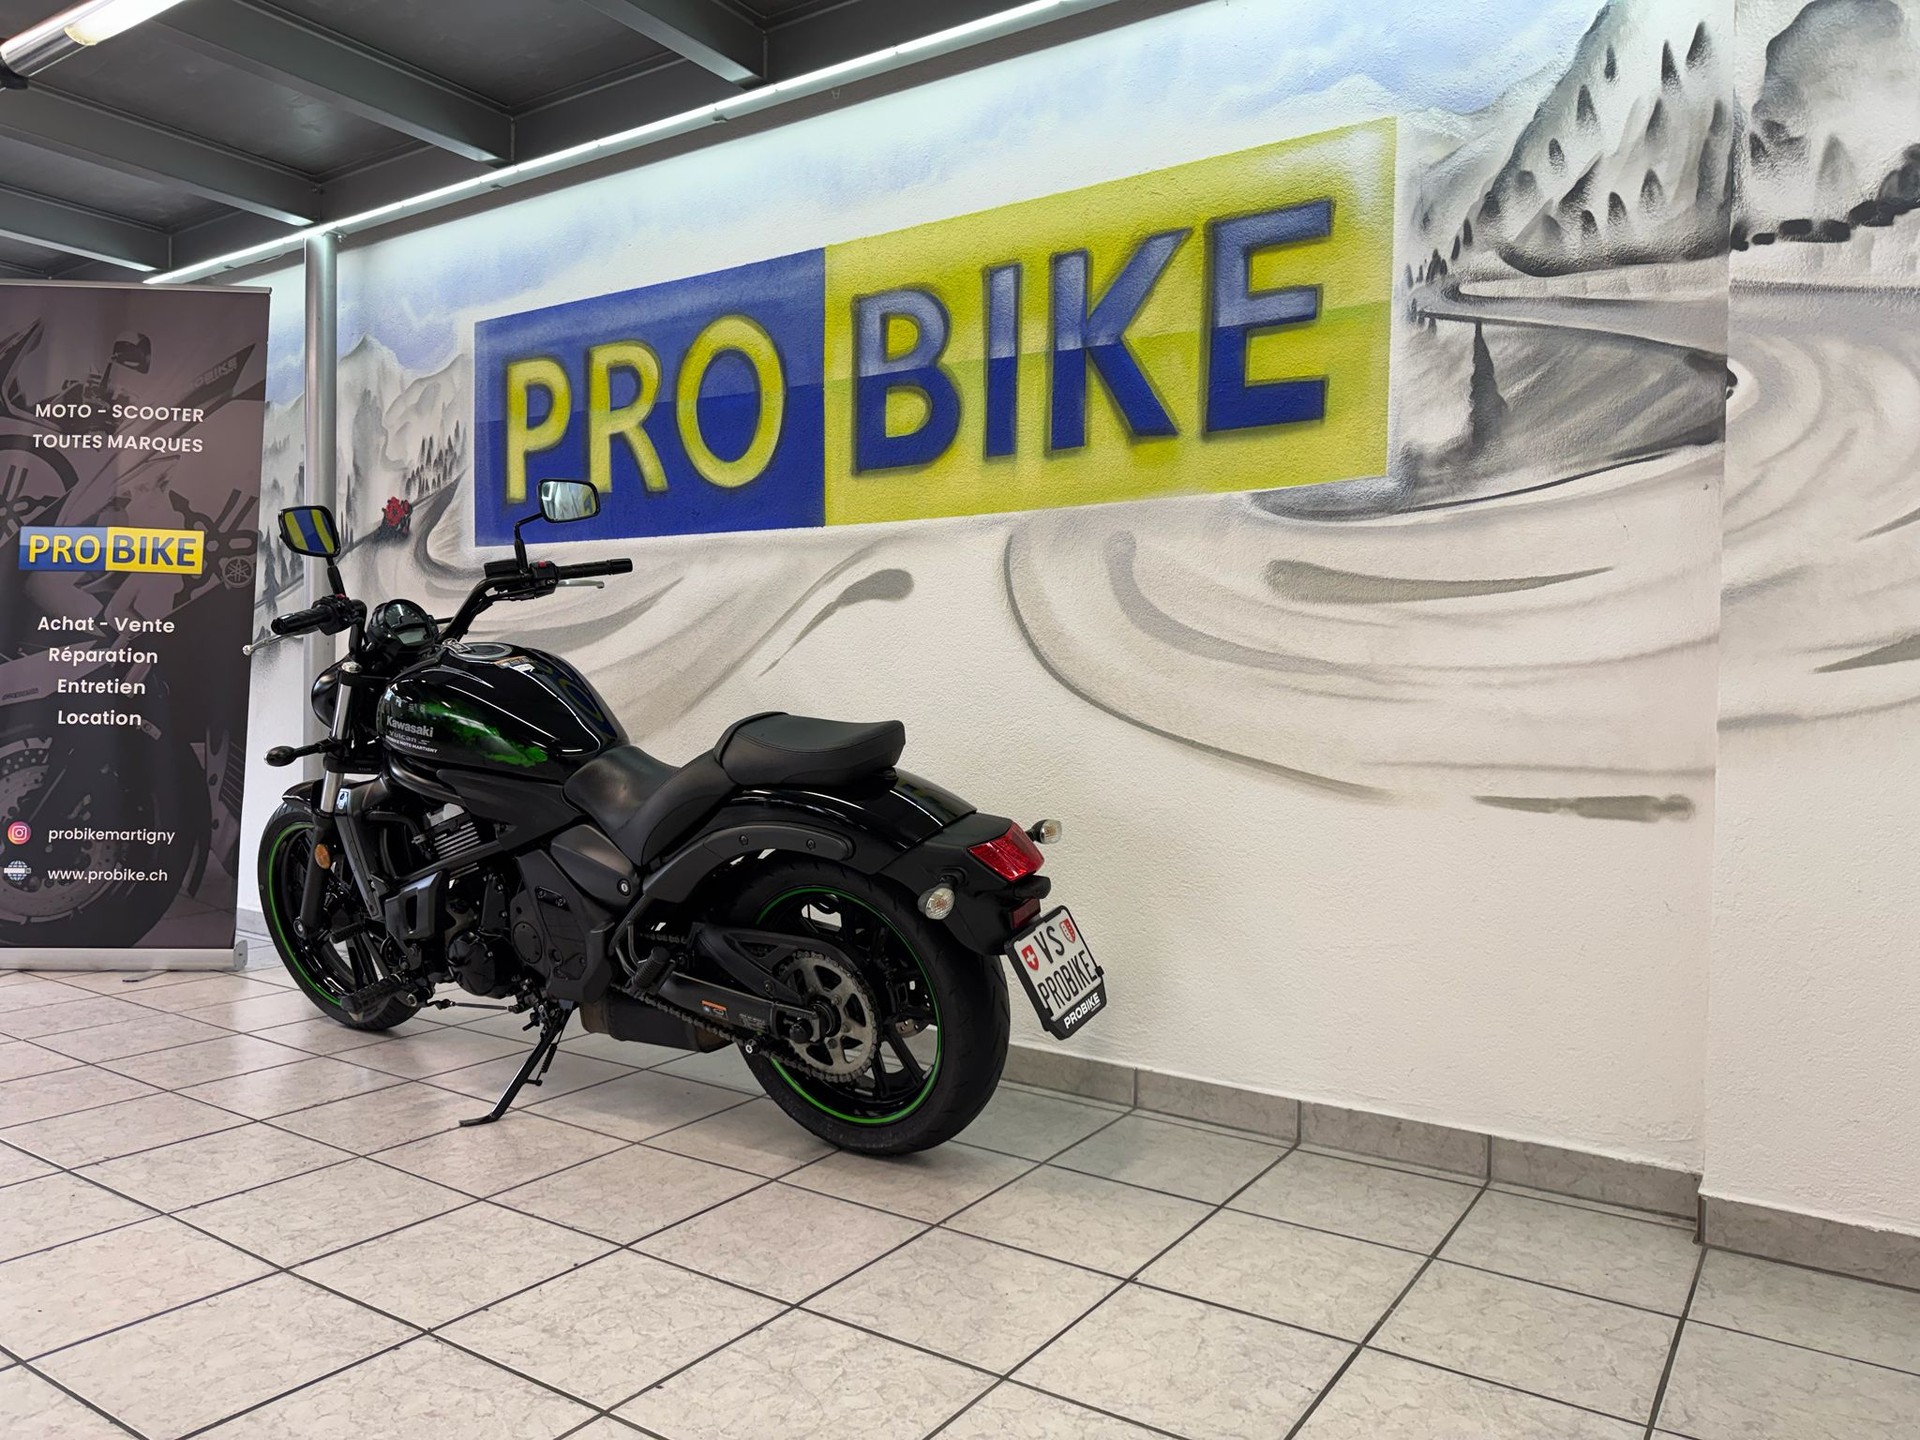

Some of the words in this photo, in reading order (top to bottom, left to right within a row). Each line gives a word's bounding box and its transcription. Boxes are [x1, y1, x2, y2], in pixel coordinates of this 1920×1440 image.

[505, 317, 784, 504] PRO
[852, 199, 1336, 475] BIKE
[35, 403, 92, 418] MOTO
[112, 404, 204, 423] SCOOTER
[33, 433, 103, 449] TOUTES
[107, 434, 203, 454] MARQUES
[28, 534, 101, 564] PRO
[112, 534, 196, 567] BIKE
[37, 615, 95, 631] Achat
[114, 617, 175, 633] Vente
[48, 646, 158, 667] Réparation
[57, 678, 146, 696] Entretien
[57, 709, 142, 727] Location
[386, 715, 434, 738] Kawasaki
[48, 827, 176, 846] probikemartigny
[47, 868, 169, 884] www.probike.ch
[1033, 925, 1065, 964] VS
[1037, 949, 1099, 1010] PROBIKE
[1063, 992, 1101, 1029] PROBIKE
